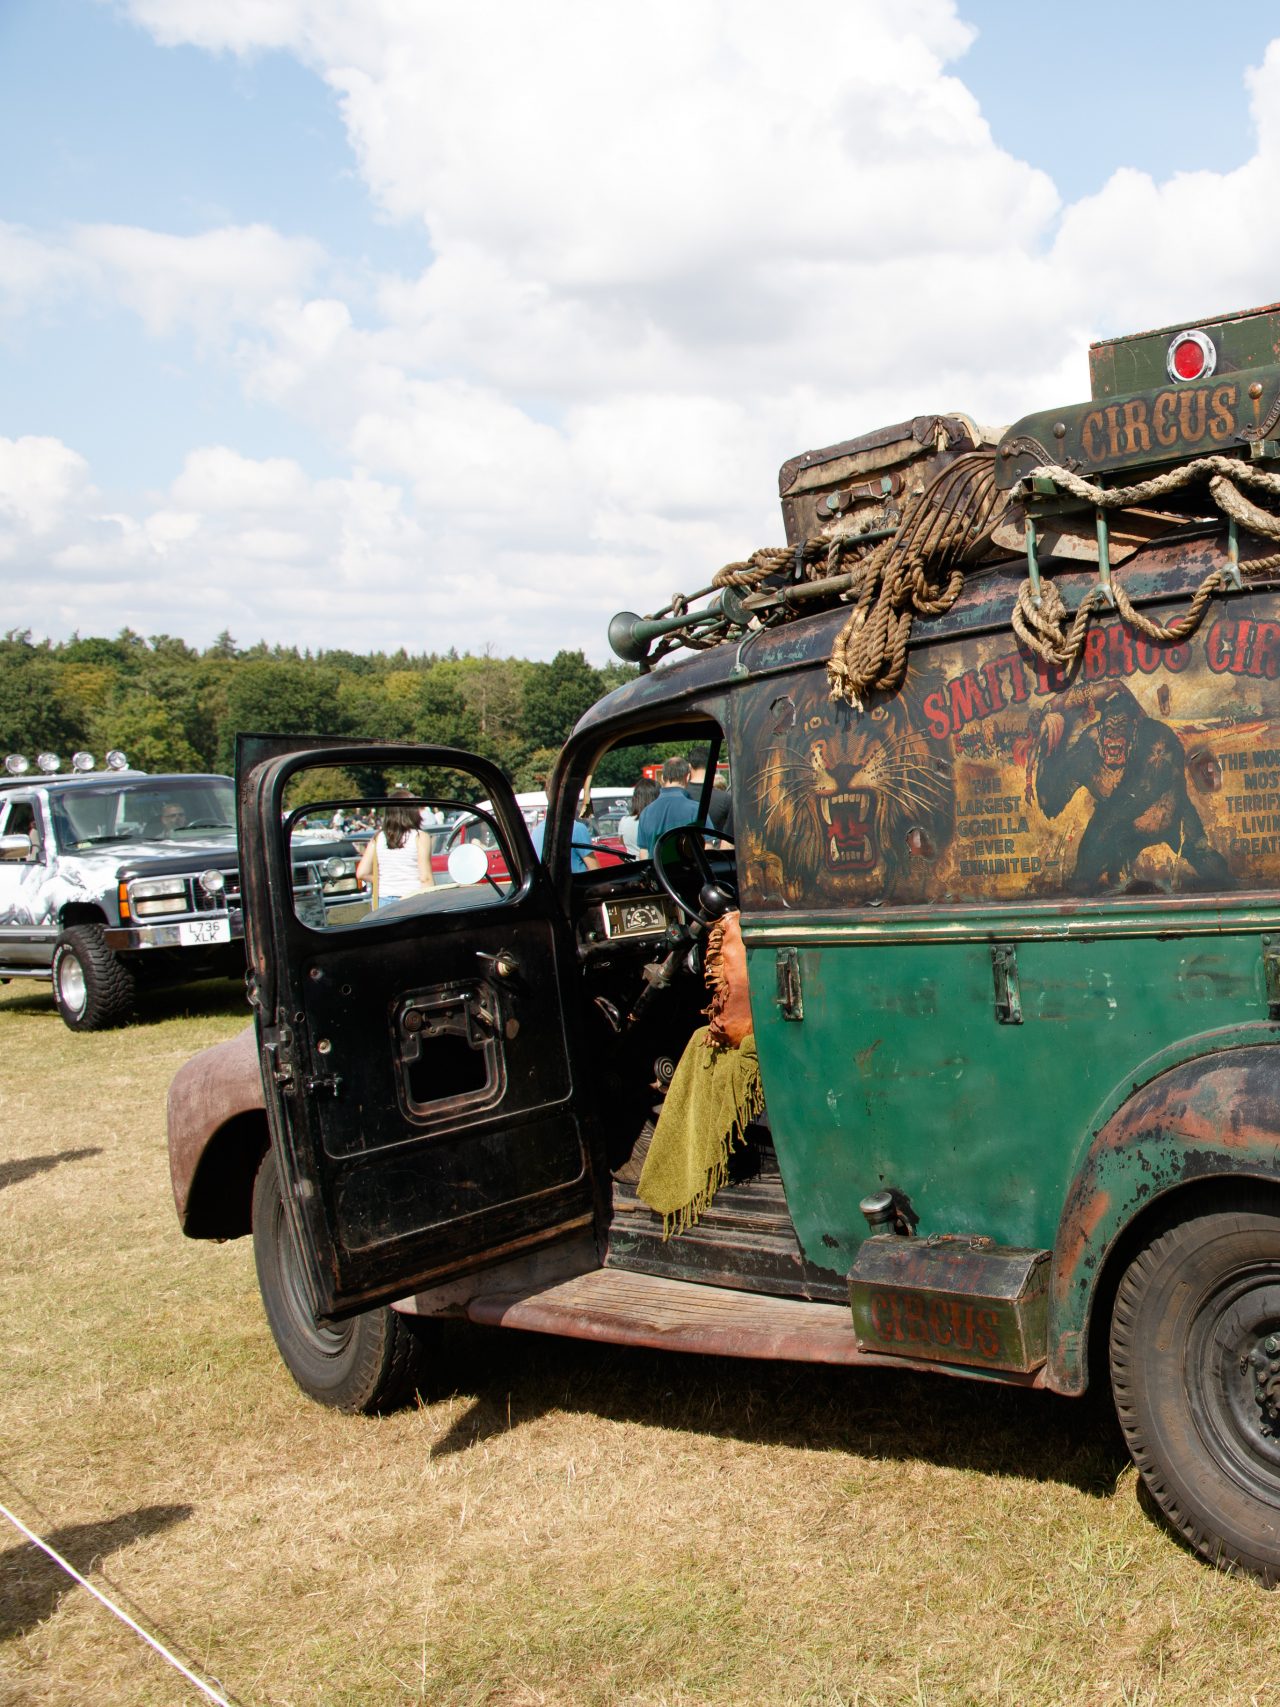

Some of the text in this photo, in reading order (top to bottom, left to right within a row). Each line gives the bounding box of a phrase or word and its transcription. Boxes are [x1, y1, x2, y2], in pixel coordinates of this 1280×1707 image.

[1081, 386, 1239, 463] CIRCUS
[1215, 752, 1248, 771] THE
[972, 777, 1002, 795] THE
[957, 796, 1021, 816] LARGEST
[957, 817, 1030, 837] GORILLA
[974, 838, 1015, 855] EVER
[959, 857, 1041, 876] EXHIBITED
[189, 921, 221, 934] L736
[194, 932, 217, 942] XLK
[870, 1294, 1000, 1358] CIRCUS
